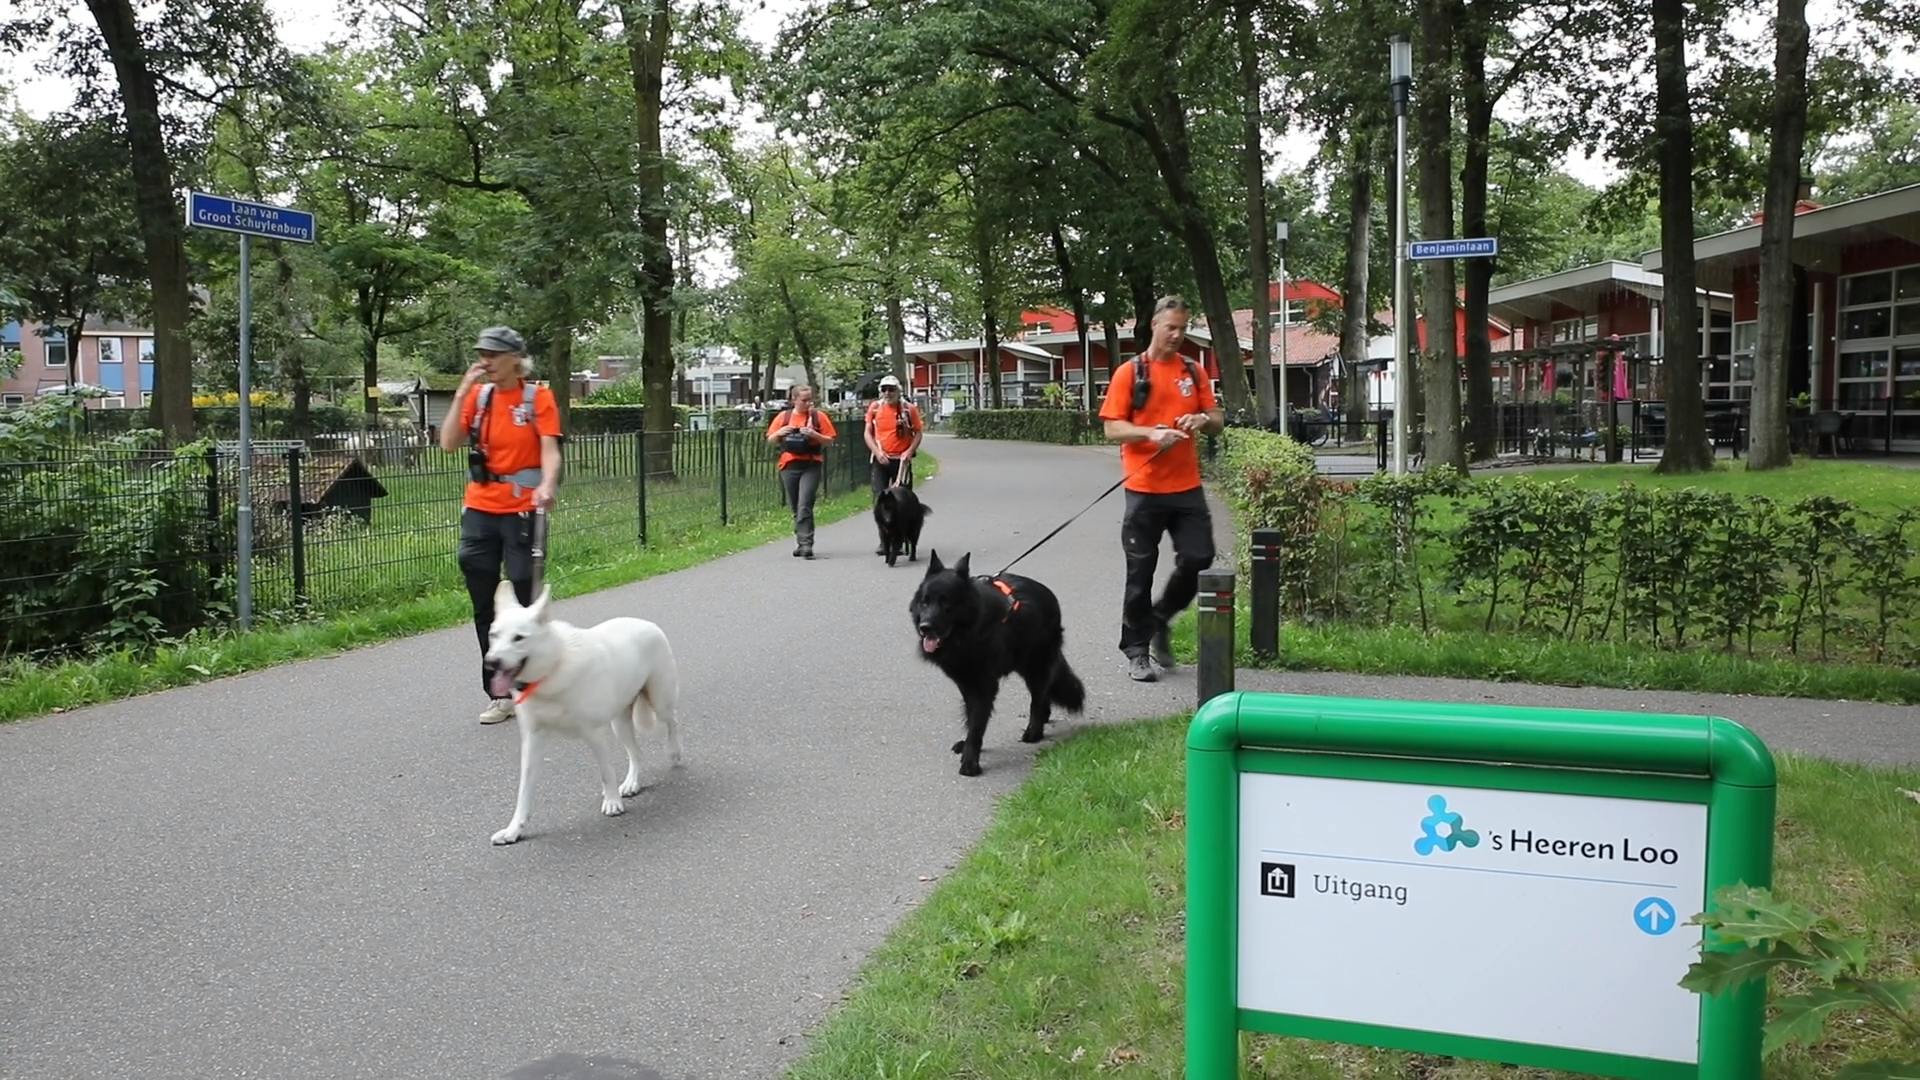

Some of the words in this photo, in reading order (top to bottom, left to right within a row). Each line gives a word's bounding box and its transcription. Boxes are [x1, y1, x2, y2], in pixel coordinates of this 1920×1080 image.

[199, 209, 232, 224] Groot
[235, 216, 308, 239] Schuylenburg
[231, 202, 257, 216] Laan
[260, 208, 279, 220] van
[1416, 242, 1490, 255] Benjaminlaan
[1489, 831, 1503, 850] 's
[1511, 829, 1614, 860] Heeren
[1623, 838, 1679, 865] Loo
[1313, 874, 1407, 906] Uitgang
